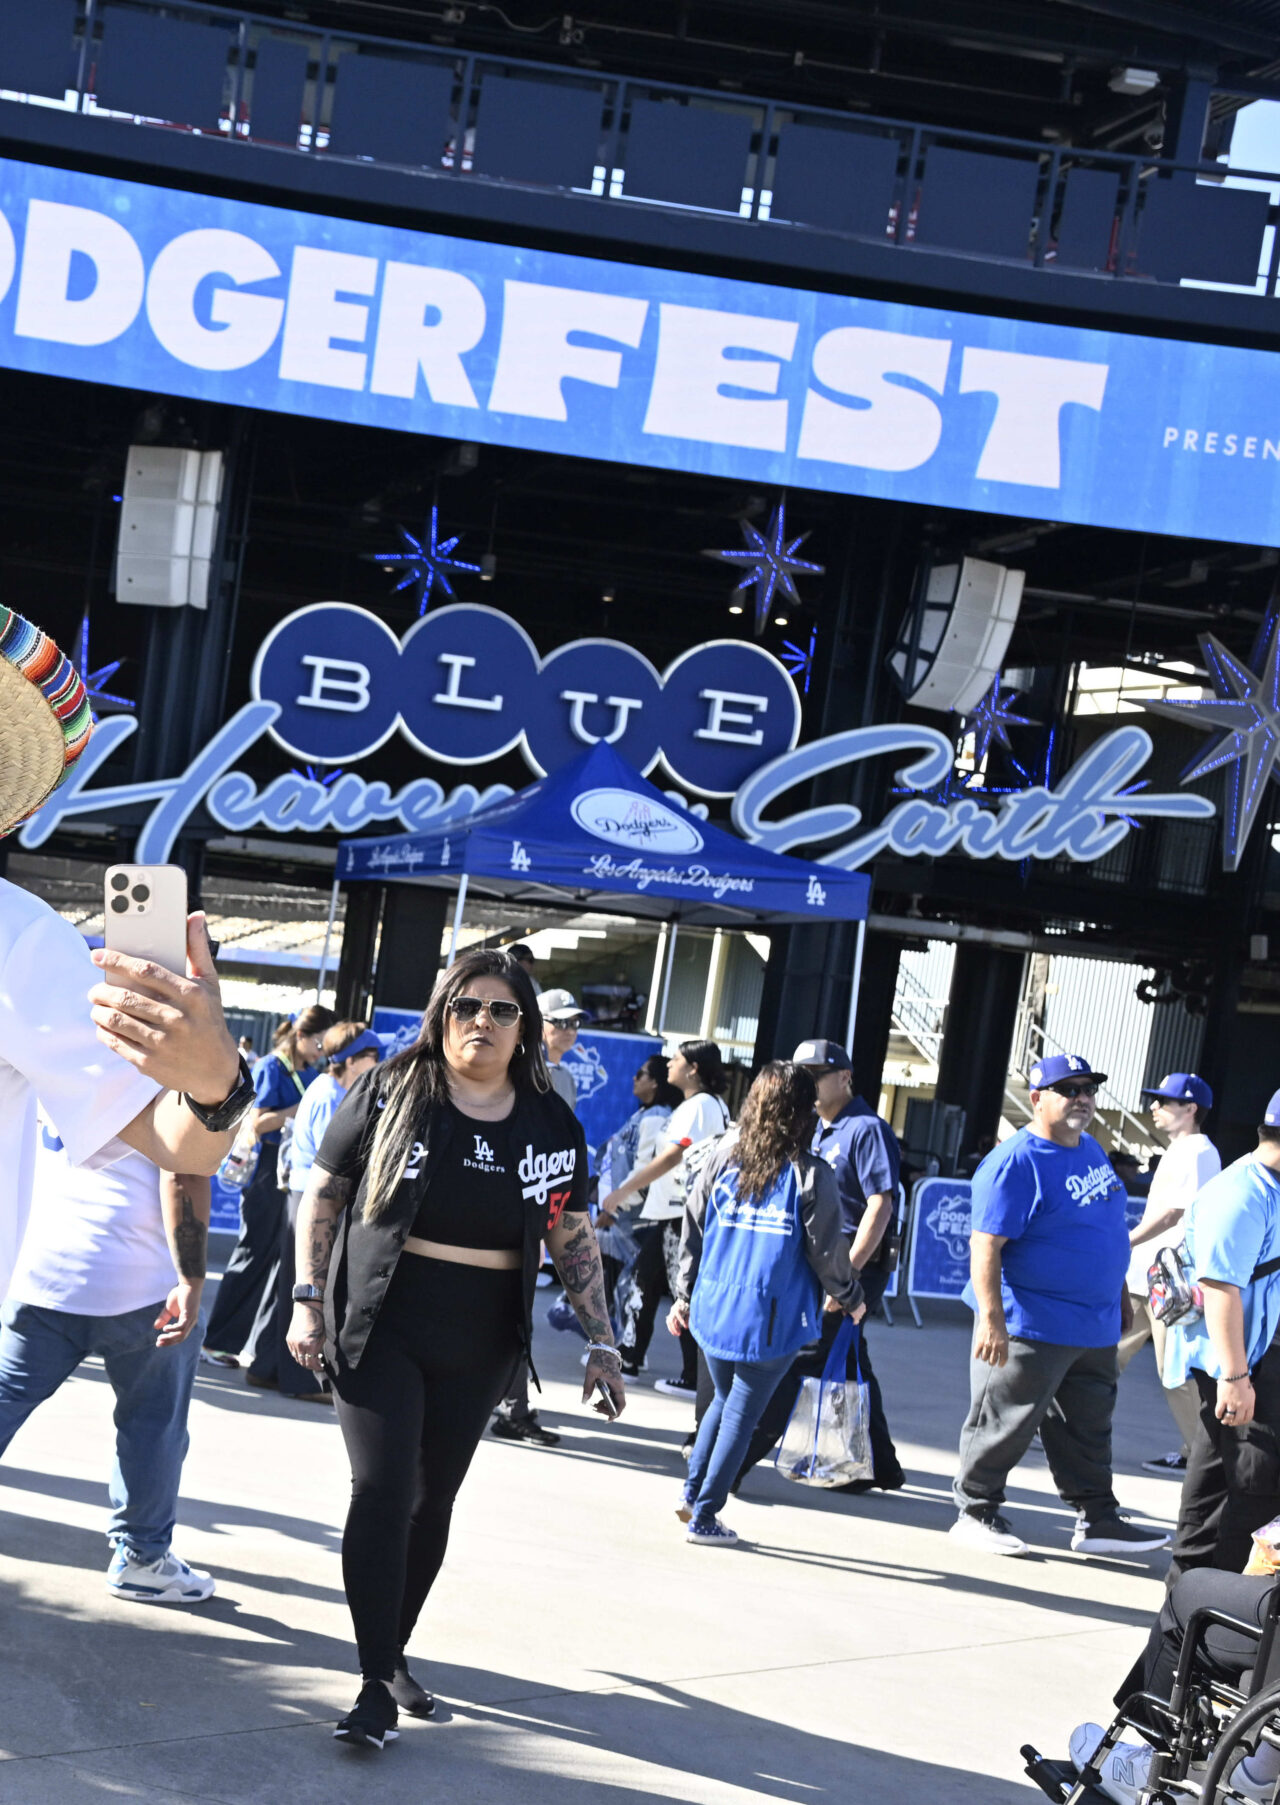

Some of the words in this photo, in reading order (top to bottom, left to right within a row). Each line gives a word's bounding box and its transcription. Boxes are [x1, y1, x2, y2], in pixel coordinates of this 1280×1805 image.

[296, 653, 769, 746] BLUE
[730, 723, 1217, 872] Earth
[595, 816, 678, 838] Dodgers
[510, 840, 532, 872] LA
[583, 854, 617, 878] Los
[614, 858, 683, 890] Angeles
[681, 865, 754, 899] Dodgers
[806, 875, 826, 906] LA
[473, 1135, 494, 1162] LA
[463, 1158, 506, 1174] Dodgers
[938, 1221, 972, 1235] FES
[940, 1211, 972, 1221] DODG
